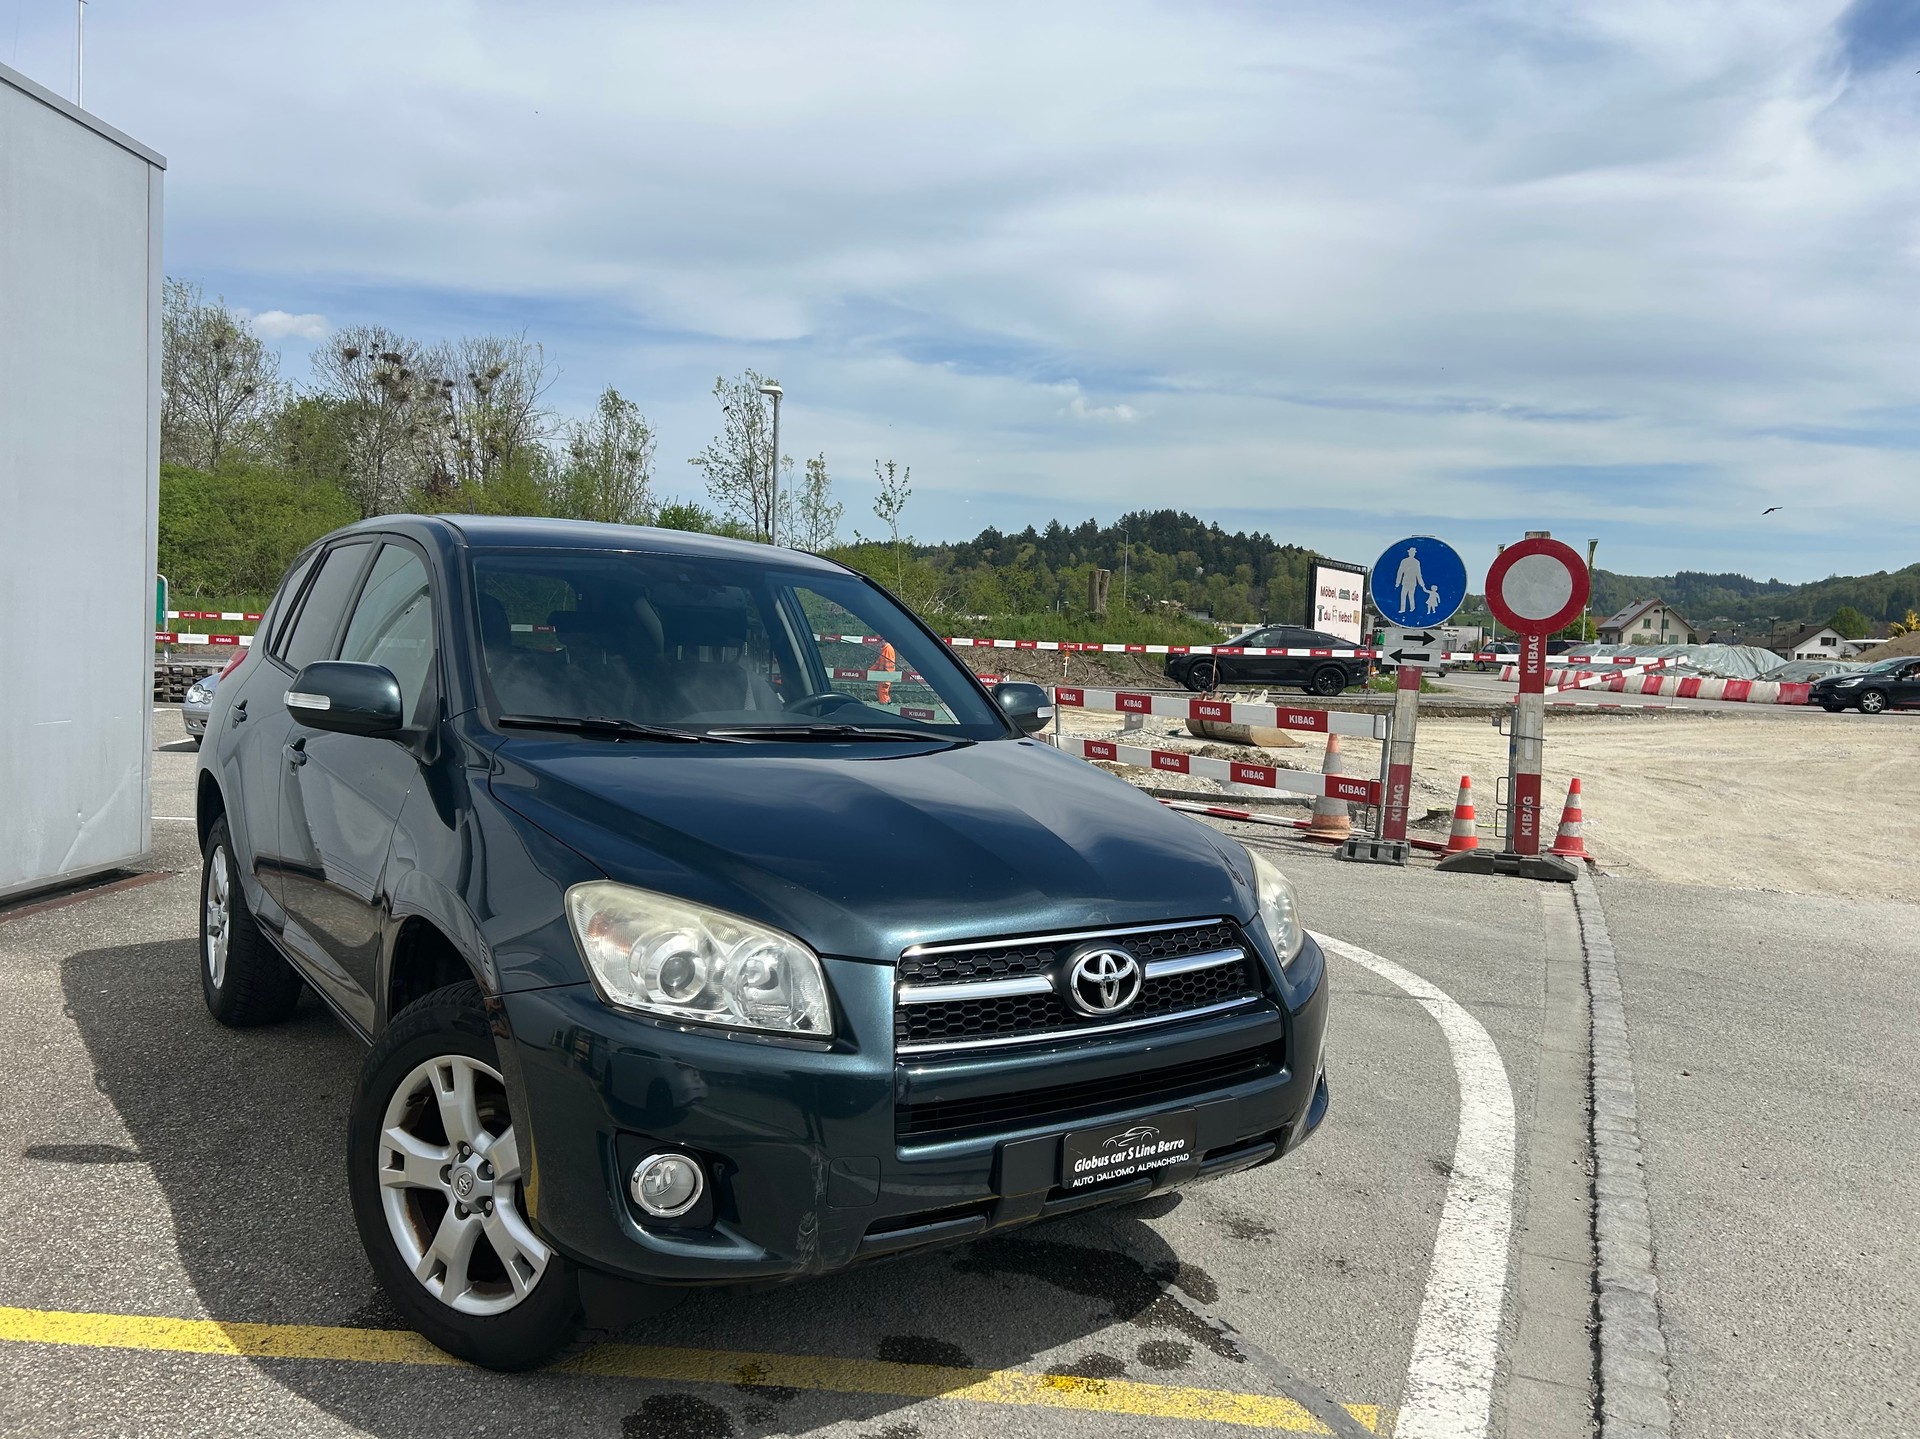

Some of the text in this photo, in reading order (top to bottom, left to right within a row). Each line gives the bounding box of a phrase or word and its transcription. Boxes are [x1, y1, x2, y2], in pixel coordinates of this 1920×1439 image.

[1323, 610, 1331, 620] du
[1527, 635, 1539, 674] KIBAG
[1060, 692, 1076, 702] KIBAG
[1123, 699, 1142, 709] KIBAG
[1199, 706, 1221, 716] KIBAG
[1289, 714, 1315, 726] KIBAG
[1091, 745, 1109, 755] KIBAG
[1160, 756, 1180, 767] KIBAG
[1241, 769, 1264, 781] KIBAG
[1338, 783, 1367, 796] KIBAG
[1391, 784, 1405, 822] KIBAG
[1521, 796, 1534, 836] KIBAG
[1074, 1138, 1185, 1172] Globus car S Line Berro
[1072, 1153, 1190, 1188] AUTO DALL'OMO ALPNACHSTAD
